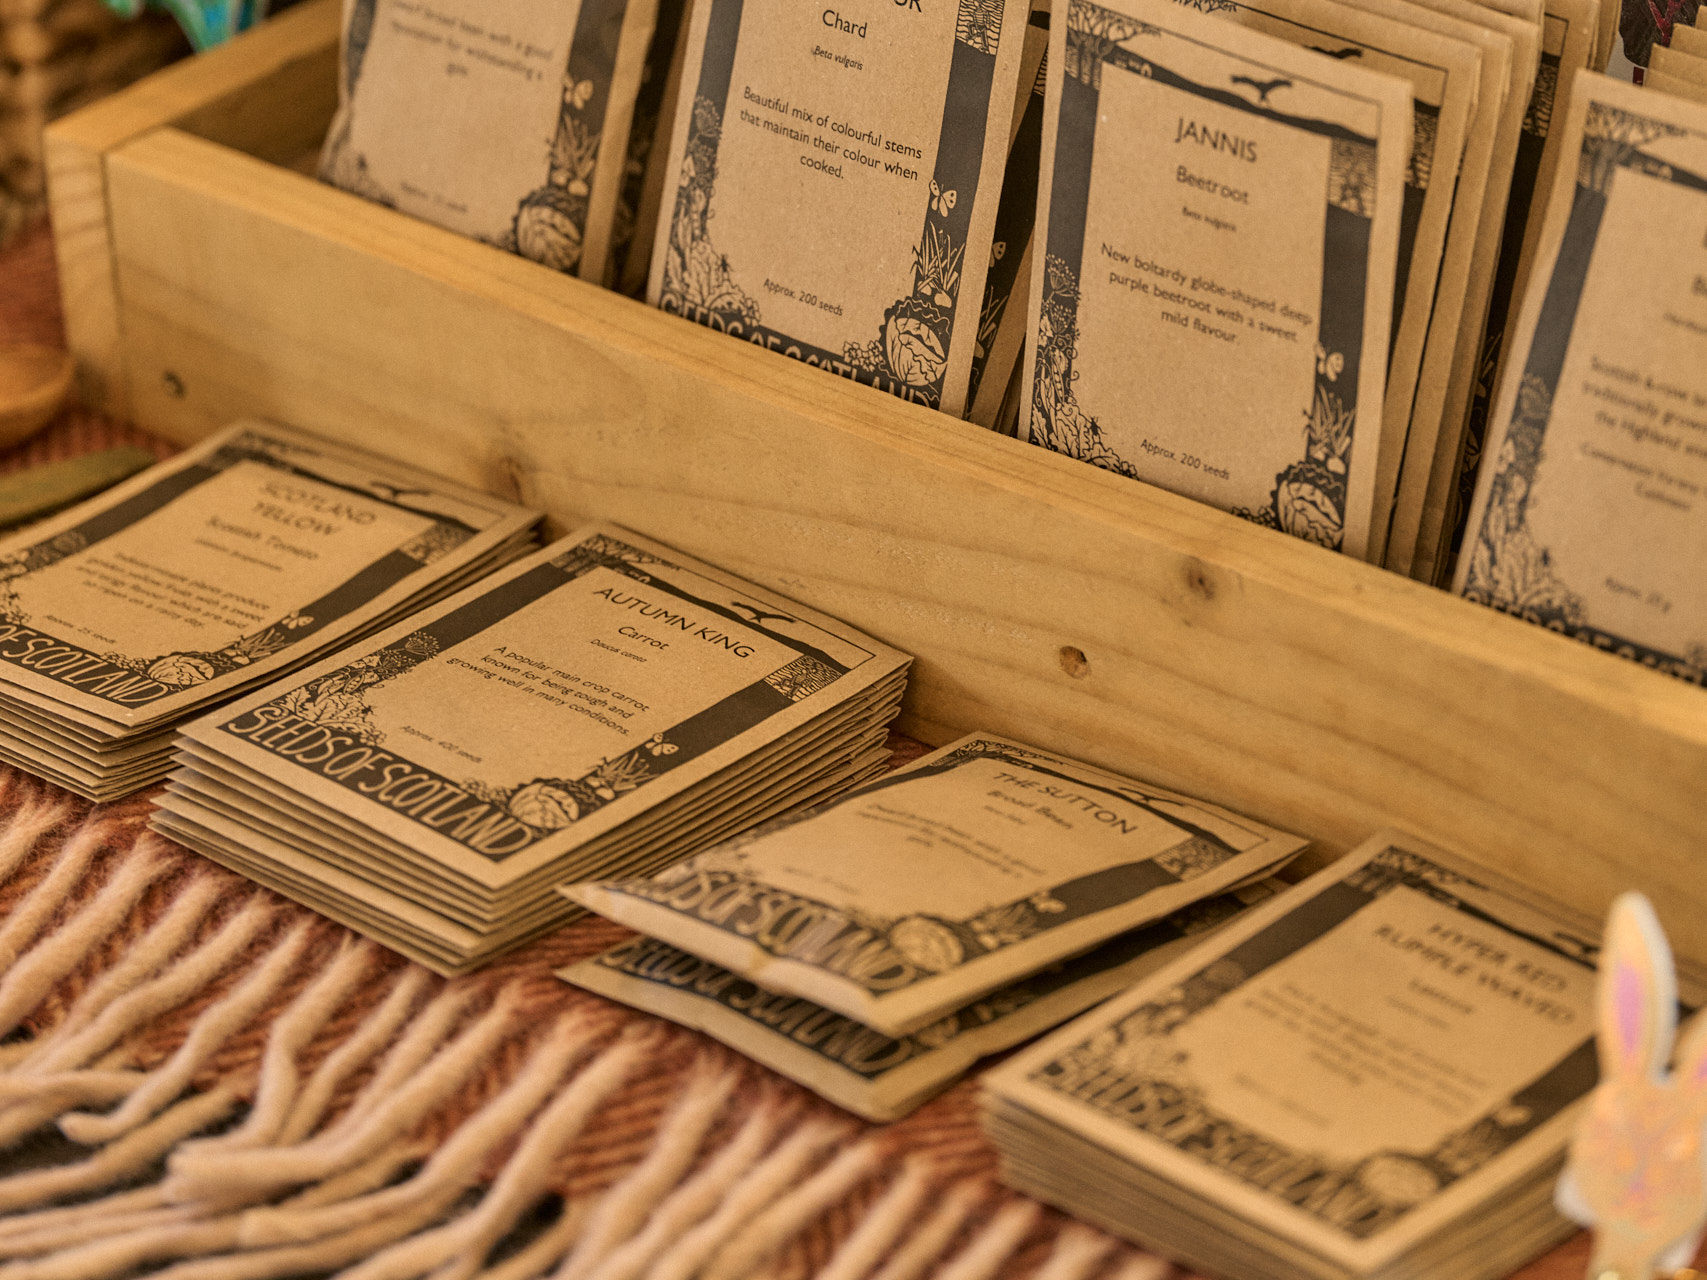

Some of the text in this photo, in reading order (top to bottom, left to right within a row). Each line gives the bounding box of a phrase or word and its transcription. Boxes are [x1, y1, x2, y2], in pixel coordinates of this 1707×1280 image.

[822, 9, 868, 39] Chard
[813, 45, 864, 71] Beta vulgaris
[740, 109, 918, 181] that maintain their colour when
[743, 86, 922, 160] Beautiful mix of colourful stems
[1174, 117, 1257, 163] JANNIS
[800, 154, 844, 180] cooked.
[1176, 165, 1248, 204] Beetroot
[763, 278, 844, 317] Approx. 200 seeds
[1101, 242, 1131, 265] New
[1134, 255, 1187, 286] boltardy
[1190, 276, 1276, 313] globe-shaped
[1109, 271, 1298, 343] purple beetroot with a sweet
[1161, 310, 1189, 328] mild
[1141, 439, 1230, 480] Approx. 200 seeds
[252, 500, 341, 536] YELLOW
[260, 482, 376, 525] SCOTLAND
[593, 587, 755, 659] AUTUMN KING
[618, 625, 669, 651] Carrot
[2, 638, 169, 703] SCOTLAND
[446, 656, 630, 737] growing well in many conditions.
[480, 654, 635, 719] known for being tough and
[494, 645, 650, 712] A popular main crop carrot
[228, 706, 533, 855] SEEDS OF SCOTLAND
[993, 772, 1040, 789] THE
[1038, 785, 1138, 834] SUTTON
